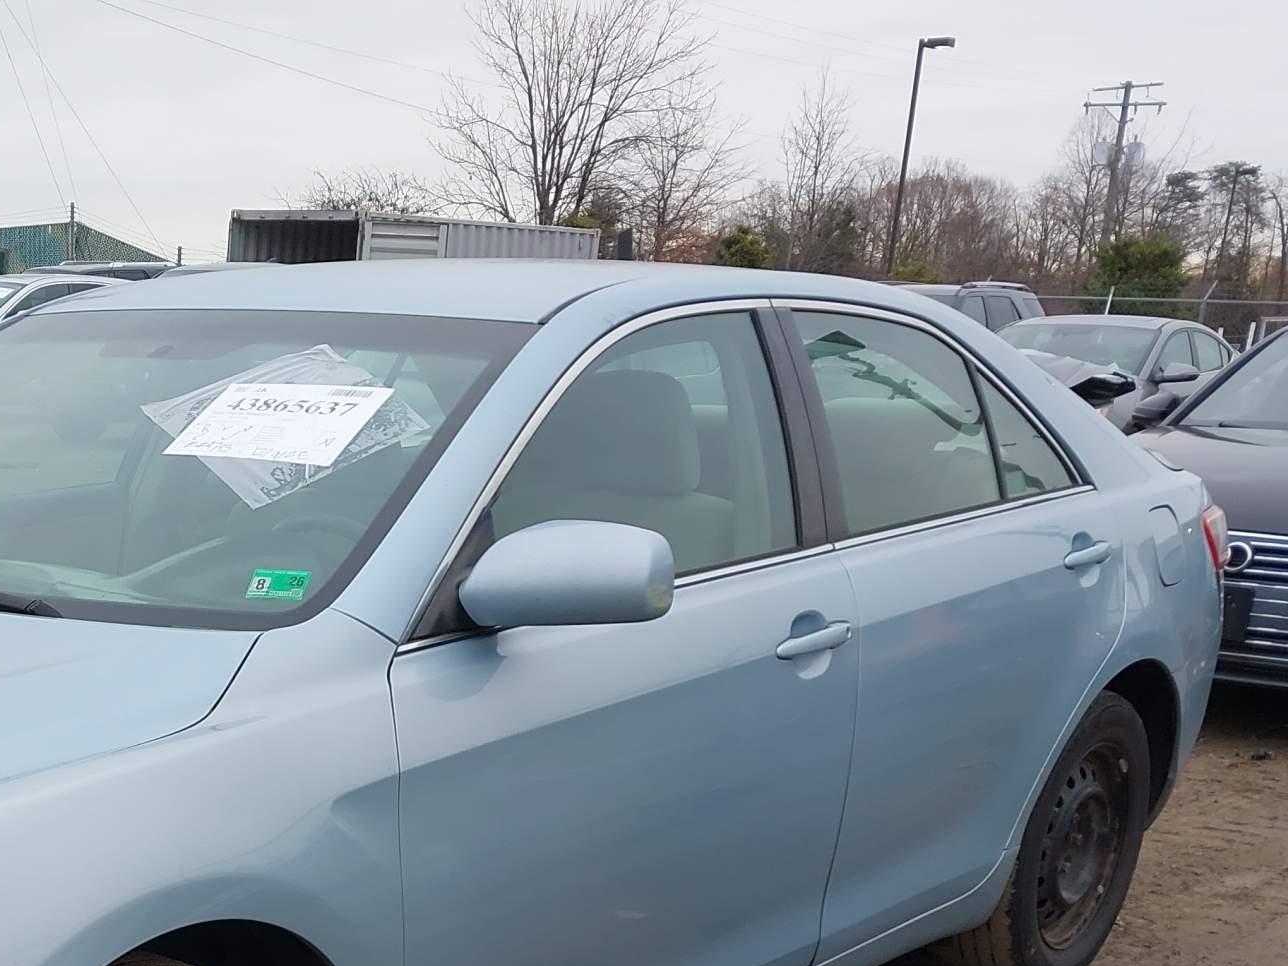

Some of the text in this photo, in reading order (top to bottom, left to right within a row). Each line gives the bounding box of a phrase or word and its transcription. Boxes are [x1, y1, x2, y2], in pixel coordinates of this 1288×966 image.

[226, 397, 360, 416] 43865637
[255, 578, 266, 590] 8
[288, 576, 305, 587] 26
